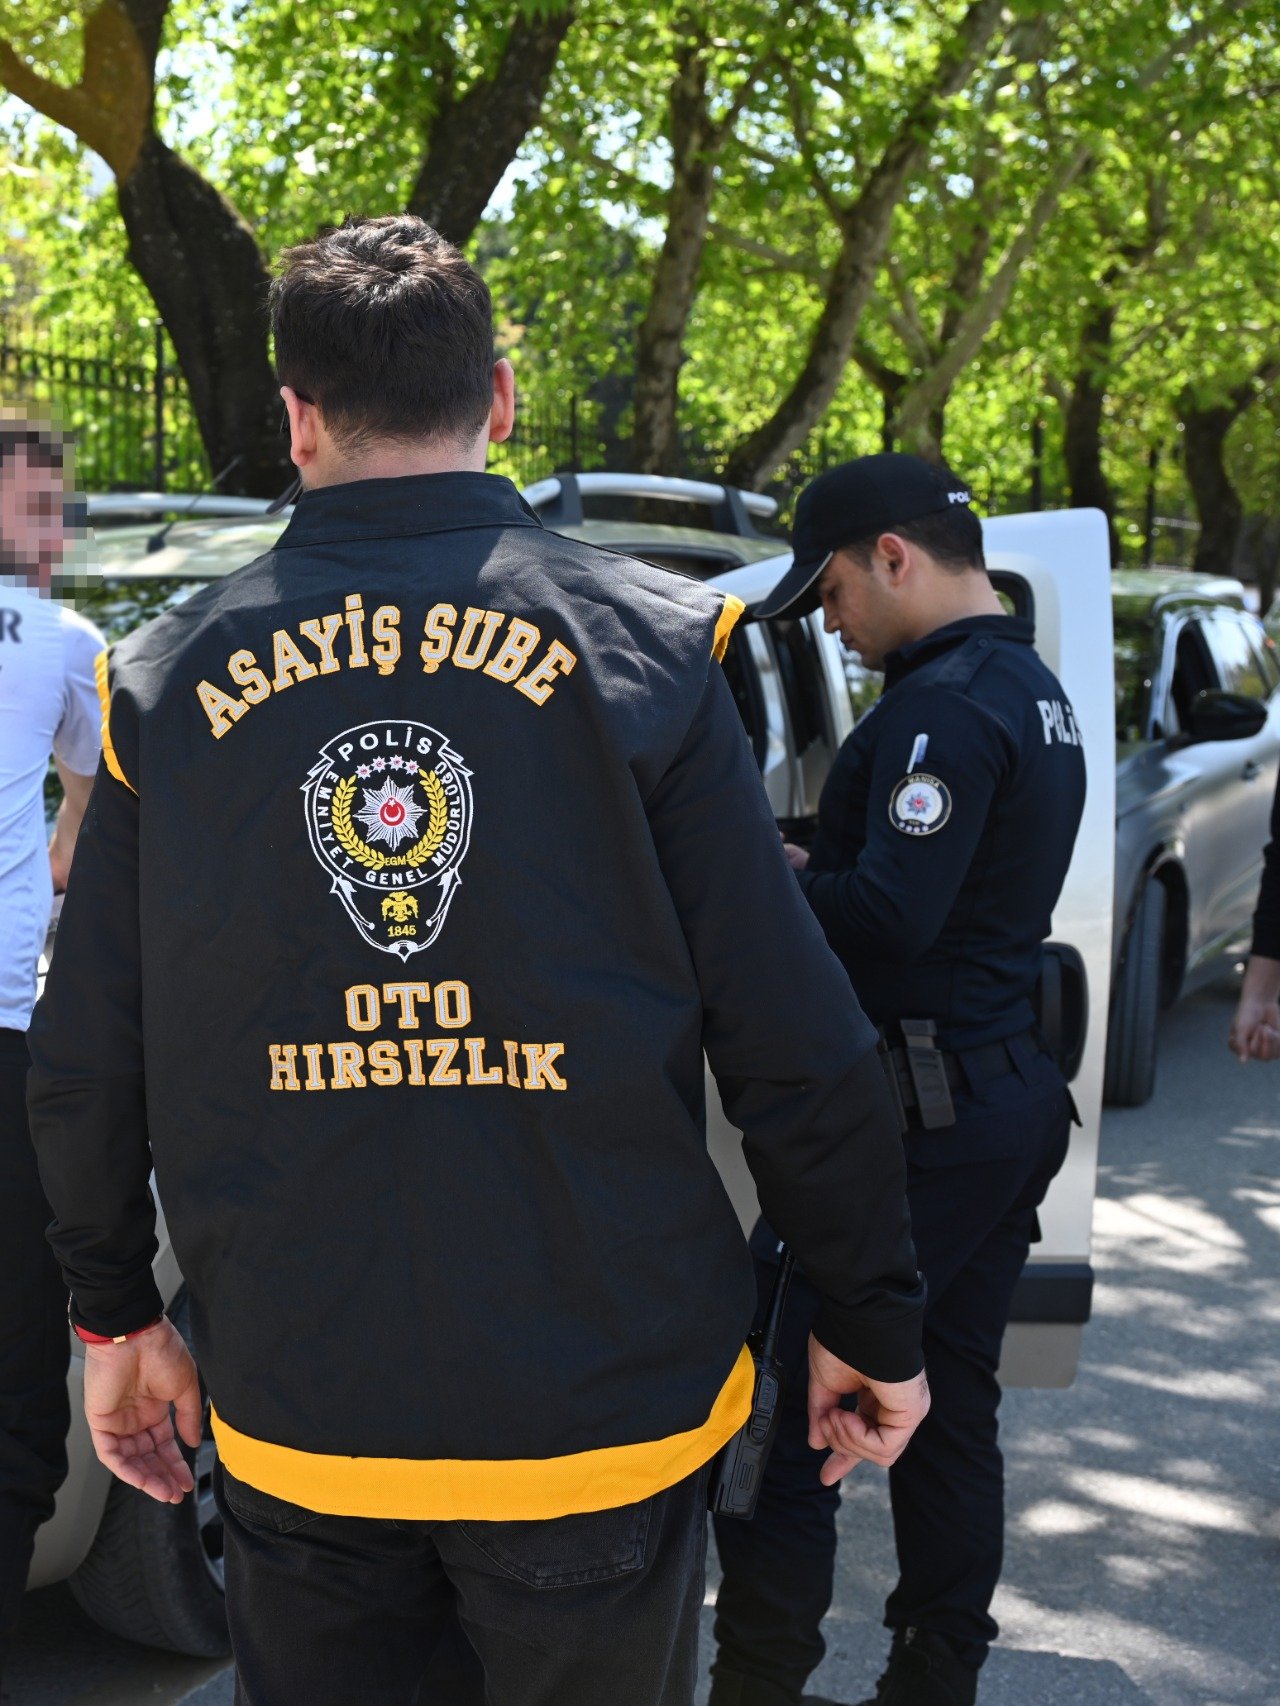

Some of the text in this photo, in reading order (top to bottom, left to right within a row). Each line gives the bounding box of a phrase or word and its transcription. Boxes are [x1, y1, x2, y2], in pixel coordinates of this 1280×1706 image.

[196, 594, 576, 739] ASAYİŞ ŞUBE
[337, 726, 433, 762] POLİS
[365, 868, 428, 885] GENEL
[387, 925, 416, 937] 1845
[345, 981, 471, 1031] OTO
[268, 1038, 567, 1091] HIRSIZLIK
